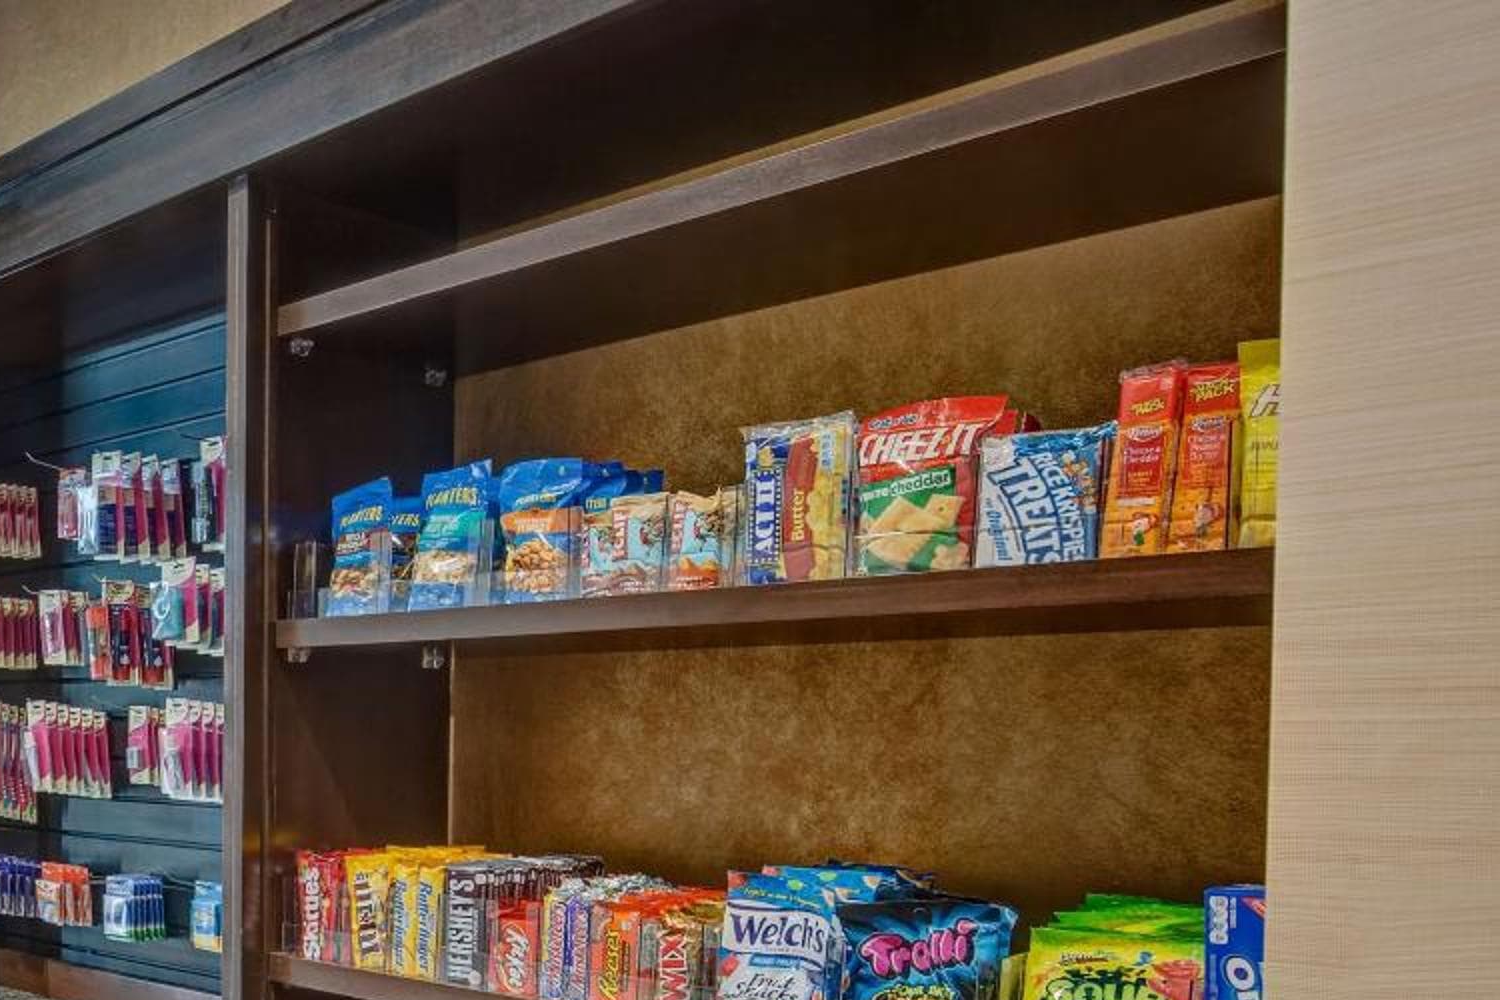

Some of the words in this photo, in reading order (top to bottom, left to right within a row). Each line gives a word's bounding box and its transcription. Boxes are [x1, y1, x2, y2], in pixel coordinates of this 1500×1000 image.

[755, 509, 775, 554] ACT
[791, 487, 805, 542] Butter
[729, 912, 825, 953] Welch's
[860, 920, 976, 977] Trolli
